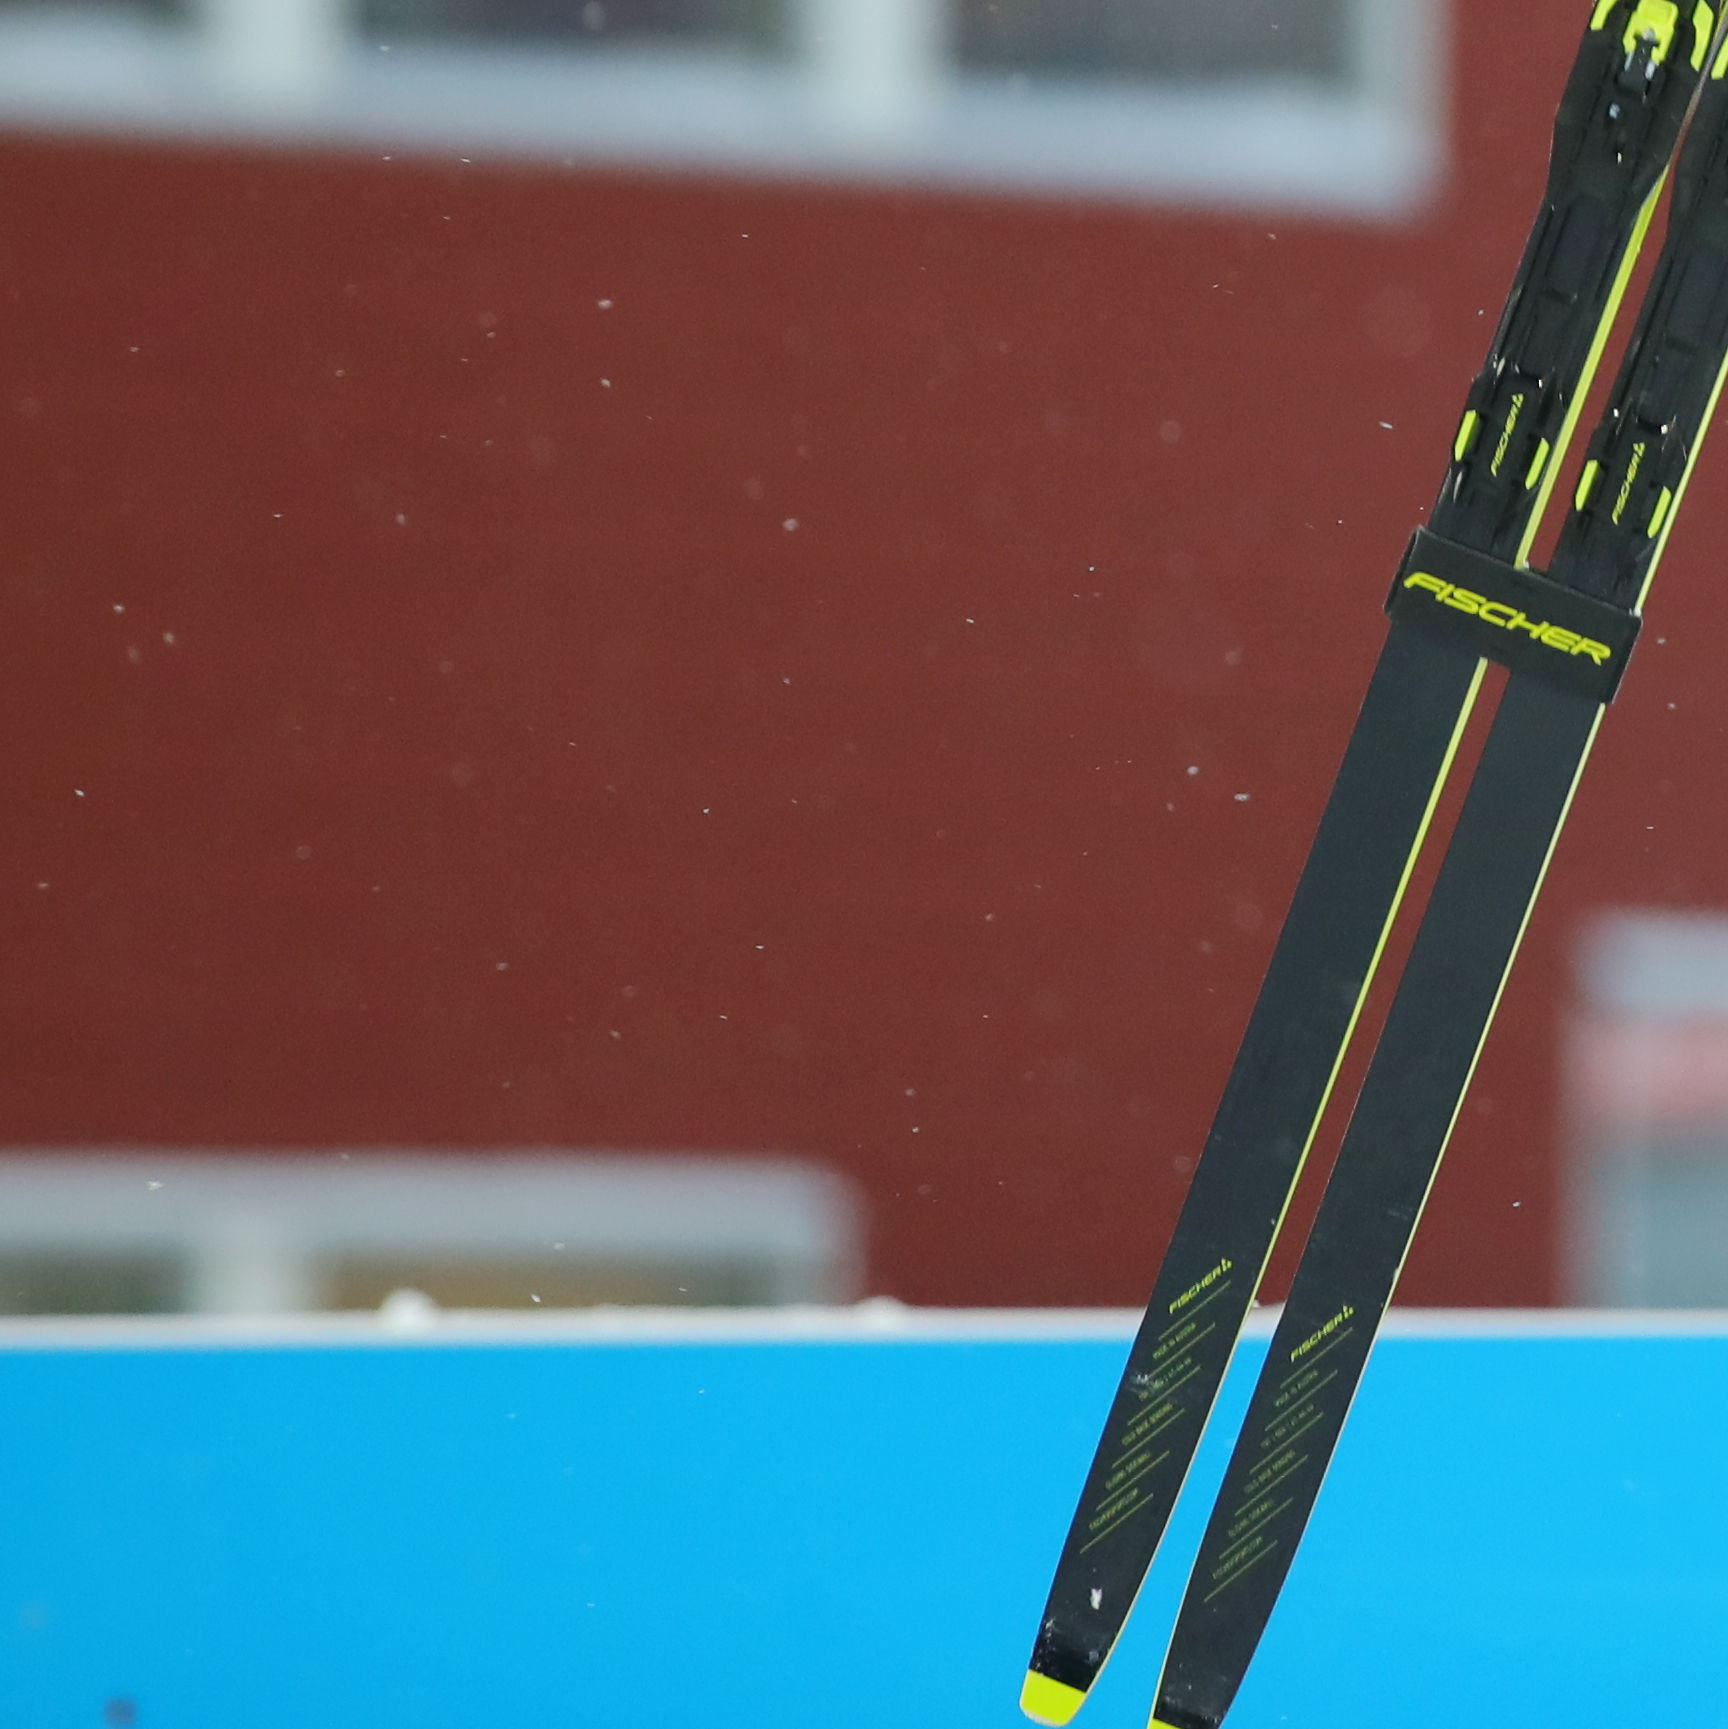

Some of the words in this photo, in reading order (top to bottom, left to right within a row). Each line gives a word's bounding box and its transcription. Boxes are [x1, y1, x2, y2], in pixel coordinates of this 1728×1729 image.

[1403, 571, 1612, 666] FISCHER
[1168, 1265, 1221, 1314] FISCHER
[1290, 1312, 1342, 1363] FISCHER
